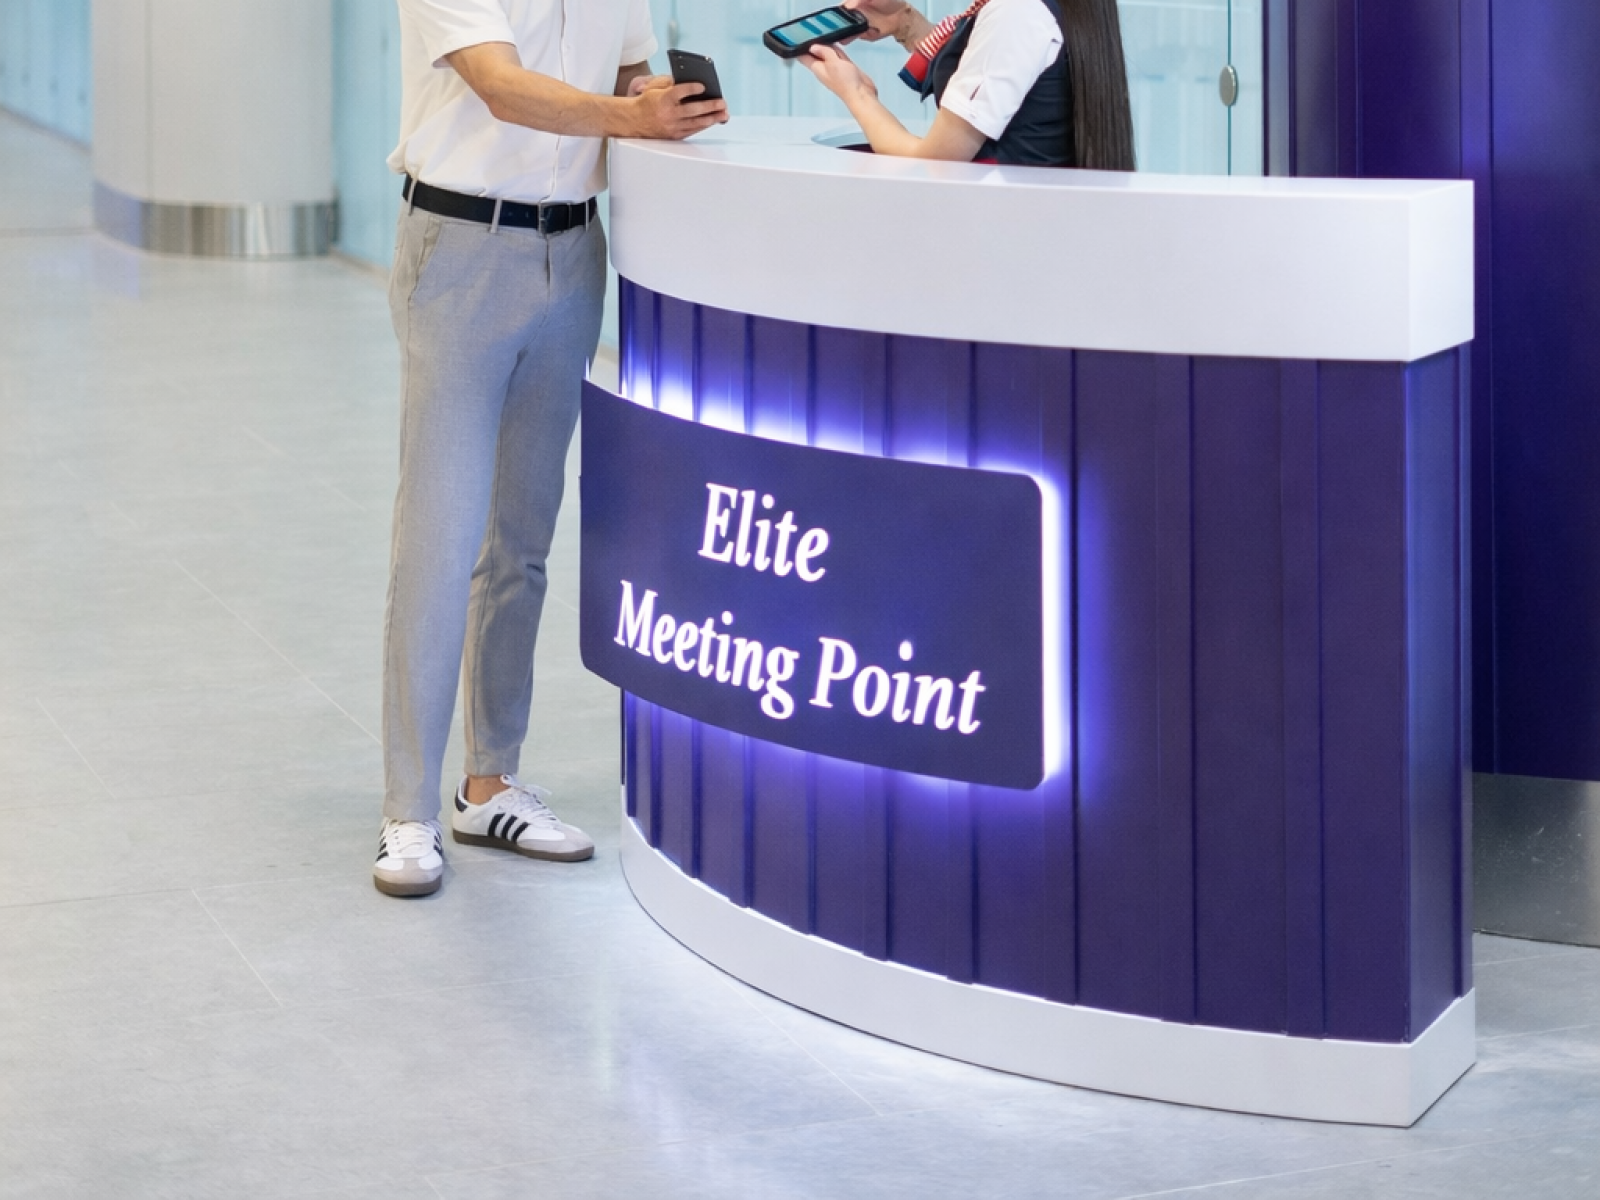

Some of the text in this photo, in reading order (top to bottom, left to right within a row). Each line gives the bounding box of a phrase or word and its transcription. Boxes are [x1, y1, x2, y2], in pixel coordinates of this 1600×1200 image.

[697, 481, 830, 583] Elite
[613, 578, 987, 735] Meeting Point
